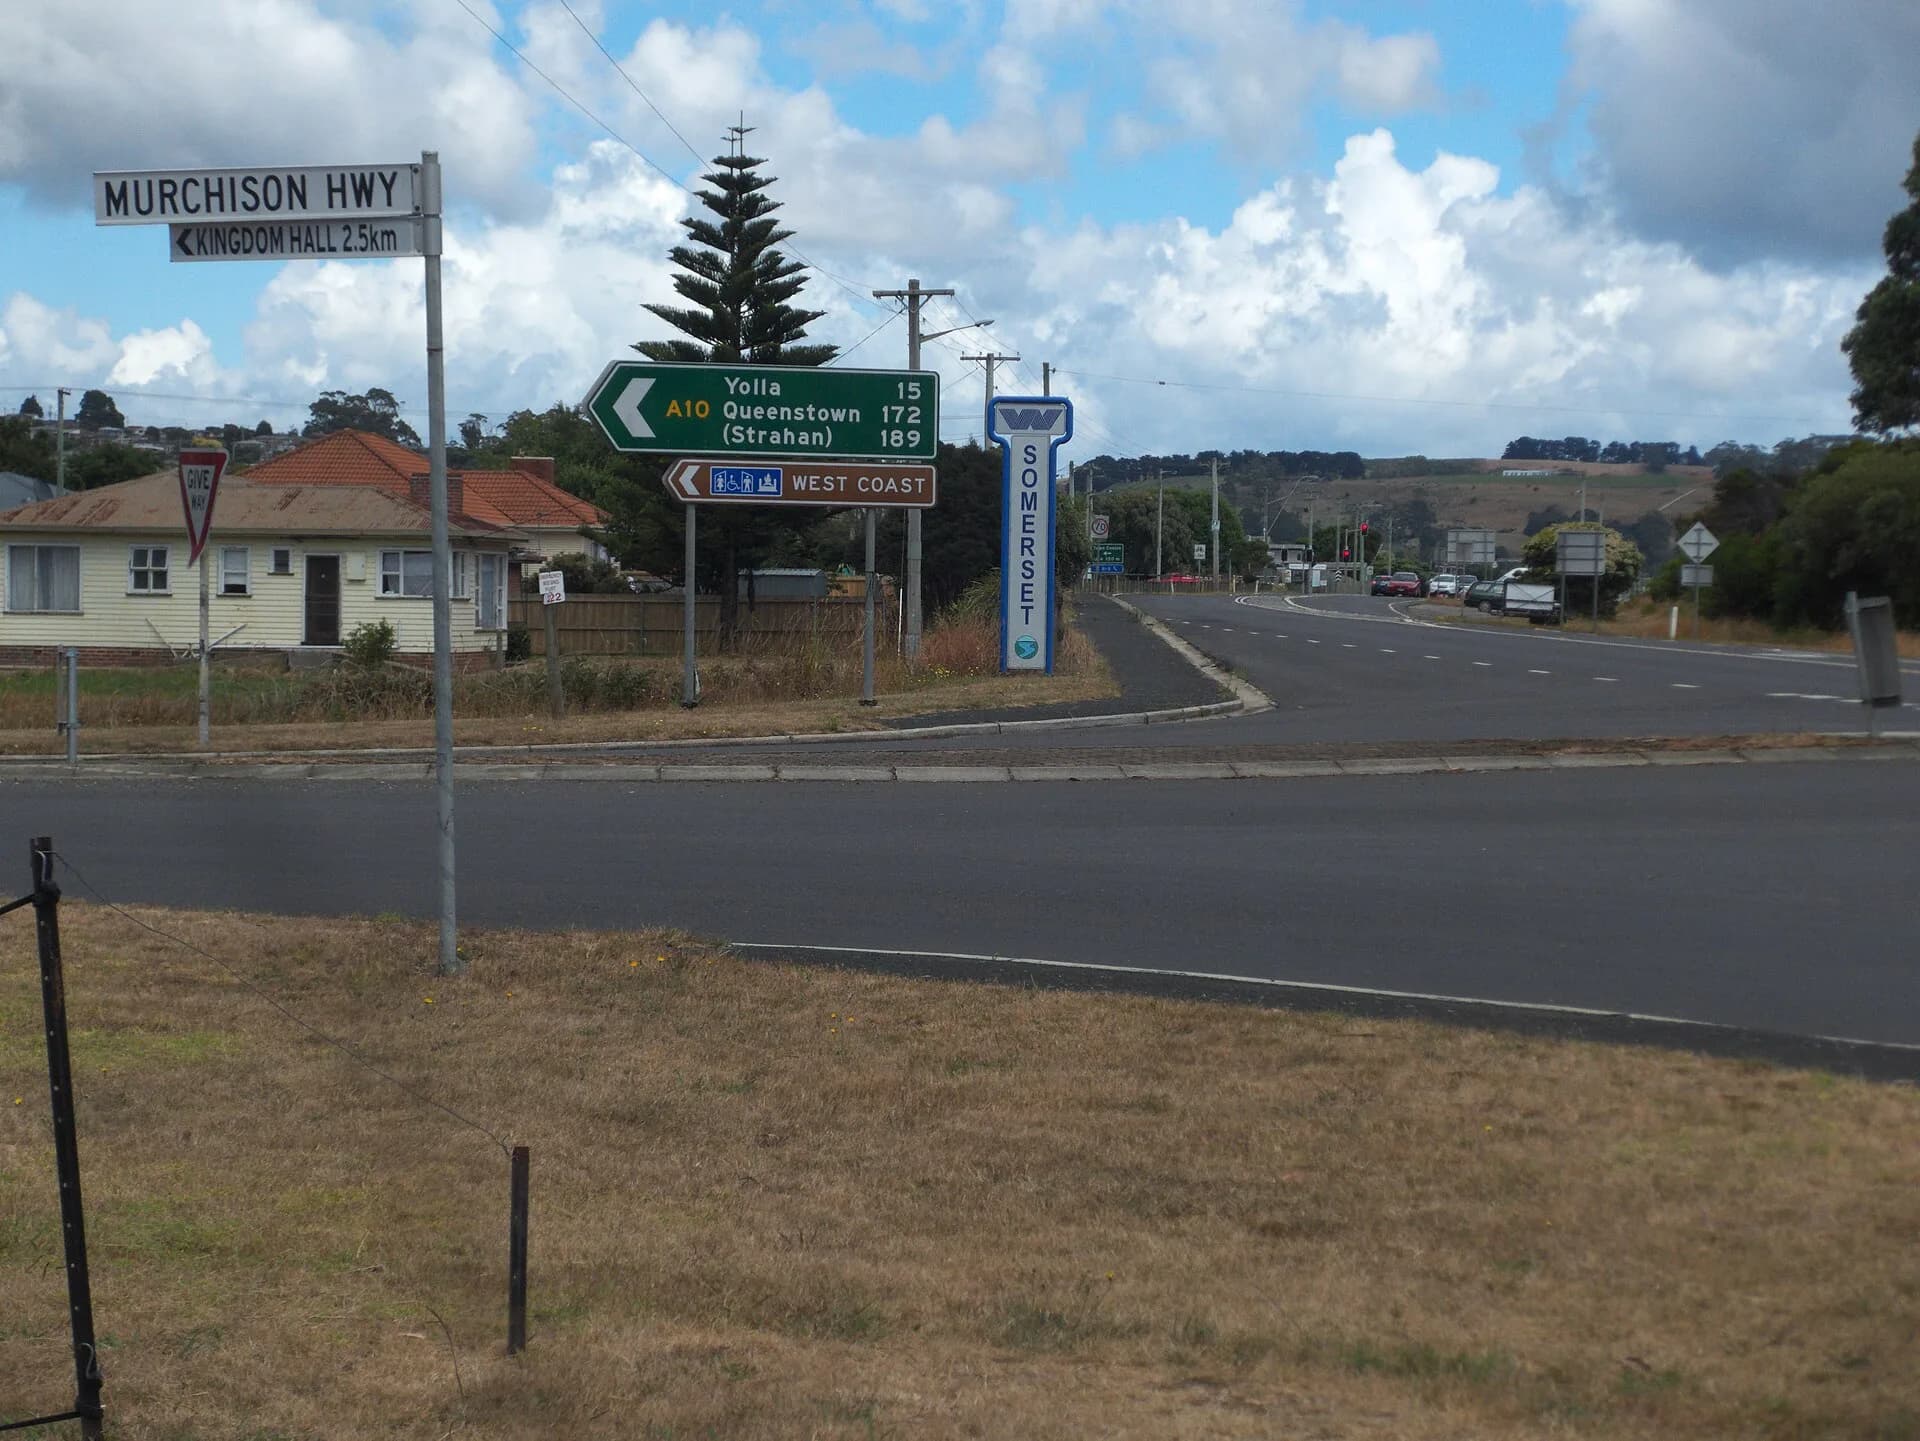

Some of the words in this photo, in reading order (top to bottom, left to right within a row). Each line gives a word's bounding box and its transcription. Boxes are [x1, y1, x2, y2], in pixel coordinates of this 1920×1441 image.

[105, 174, 307, 217] MURCHISON
[326, 171, 398, 209] HWY
[196, 225, 284, 256] KINGDOM
[290, 224, 337, 253] HALL
[342, 223, 398, 252] 2.5km
[723, 376, 781, 396] Yolla
[897, 382, 921, 400] 15
[665, 400, 711, 418] A10
[723, 401, 861, 423] Queenstown
[882, 406, 921, 424] 172
[722, 423, 833, 448] (Strahan)
[880, 430, 921, 448] 189
[187, 469, 210, 489] GIVE
[792, 474, 848, 492] WEST
[857, 476, 926, 495] COAST
[191, 495, 206, 511] WAY
[1020, 444, 1038, 625] SOMERSET
